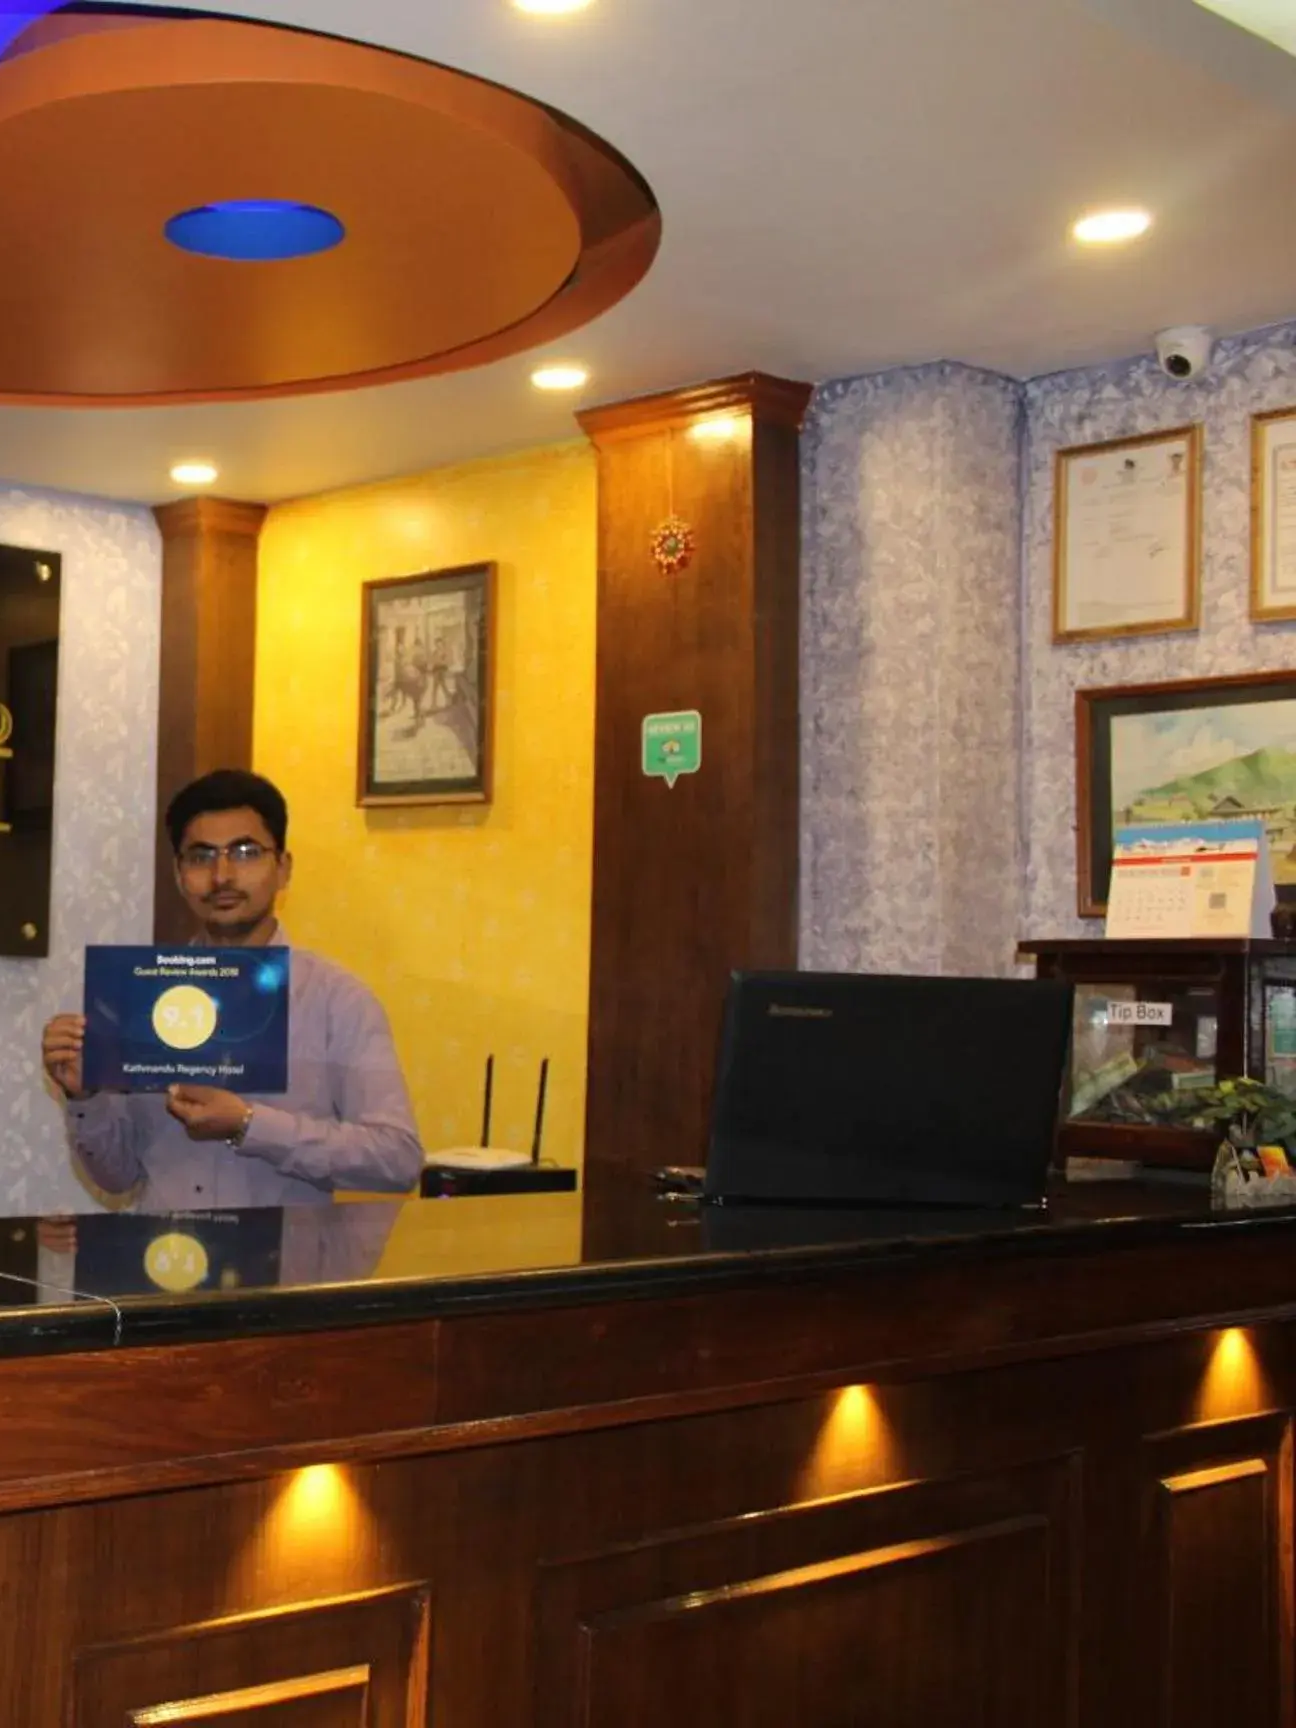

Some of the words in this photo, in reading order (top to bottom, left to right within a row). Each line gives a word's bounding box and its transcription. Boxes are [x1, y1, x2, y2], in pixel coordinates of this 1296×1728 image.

[156, 954, 216, 966] Booking.com
[133, 966, 158, 977] Guest
[159, 967, 187, 977] Review
[1111, 1003, 1132, 1020] Tip
[1136, 1004, 1166, 1020] Box
[122, 1063, 176, 1075] Kathmandu
[177, 1063, 216, 1077] Regency
